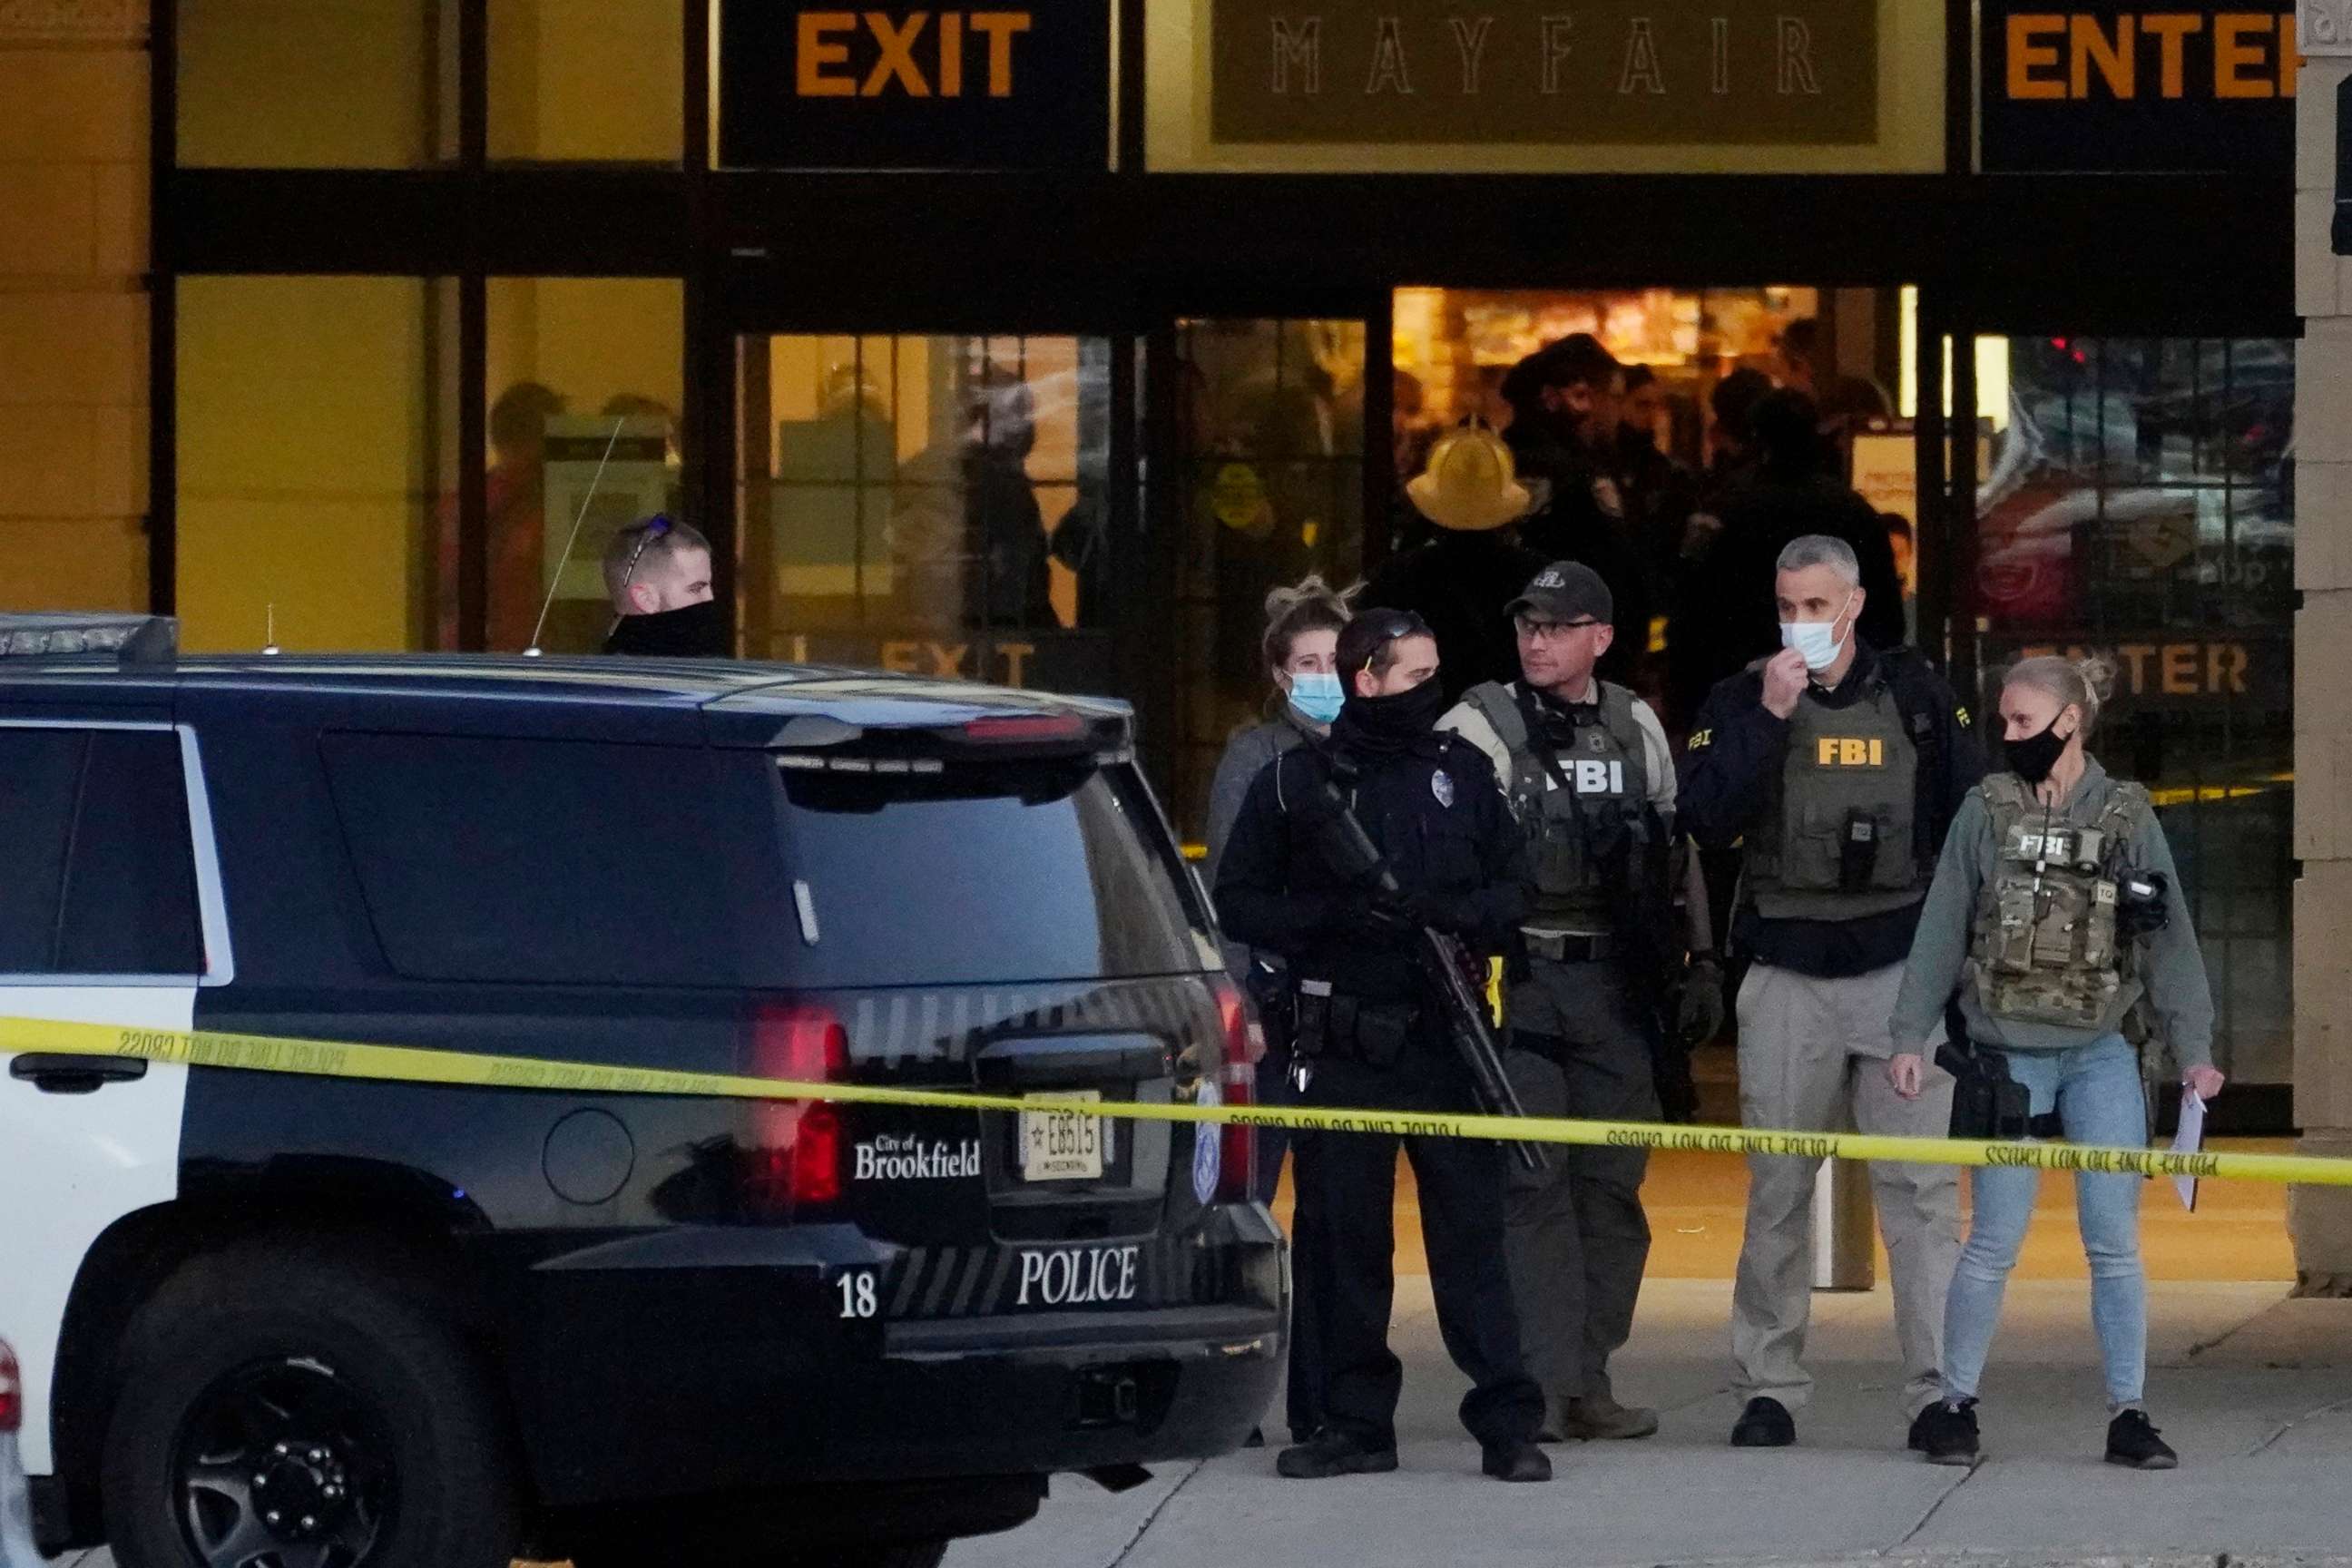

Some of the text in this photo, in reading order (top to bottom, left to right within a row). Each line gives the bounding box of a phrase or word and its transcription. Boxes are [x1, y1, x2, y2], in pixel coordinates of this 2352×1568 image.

[796, 10, 1031, 98] EXIT
[1269, 16, 1821, 93] MAYFAIR
[1818, 737, 1883, 766] FBI
[2019, 834, 2065, 857] FBI
[854, 1139, 981, 1180] Brookfield
[875, 1133, 916, 1153] City of
[837, 1271, 878, 1318] 18
[1016, 1247, 1140, 1305] POLICE
